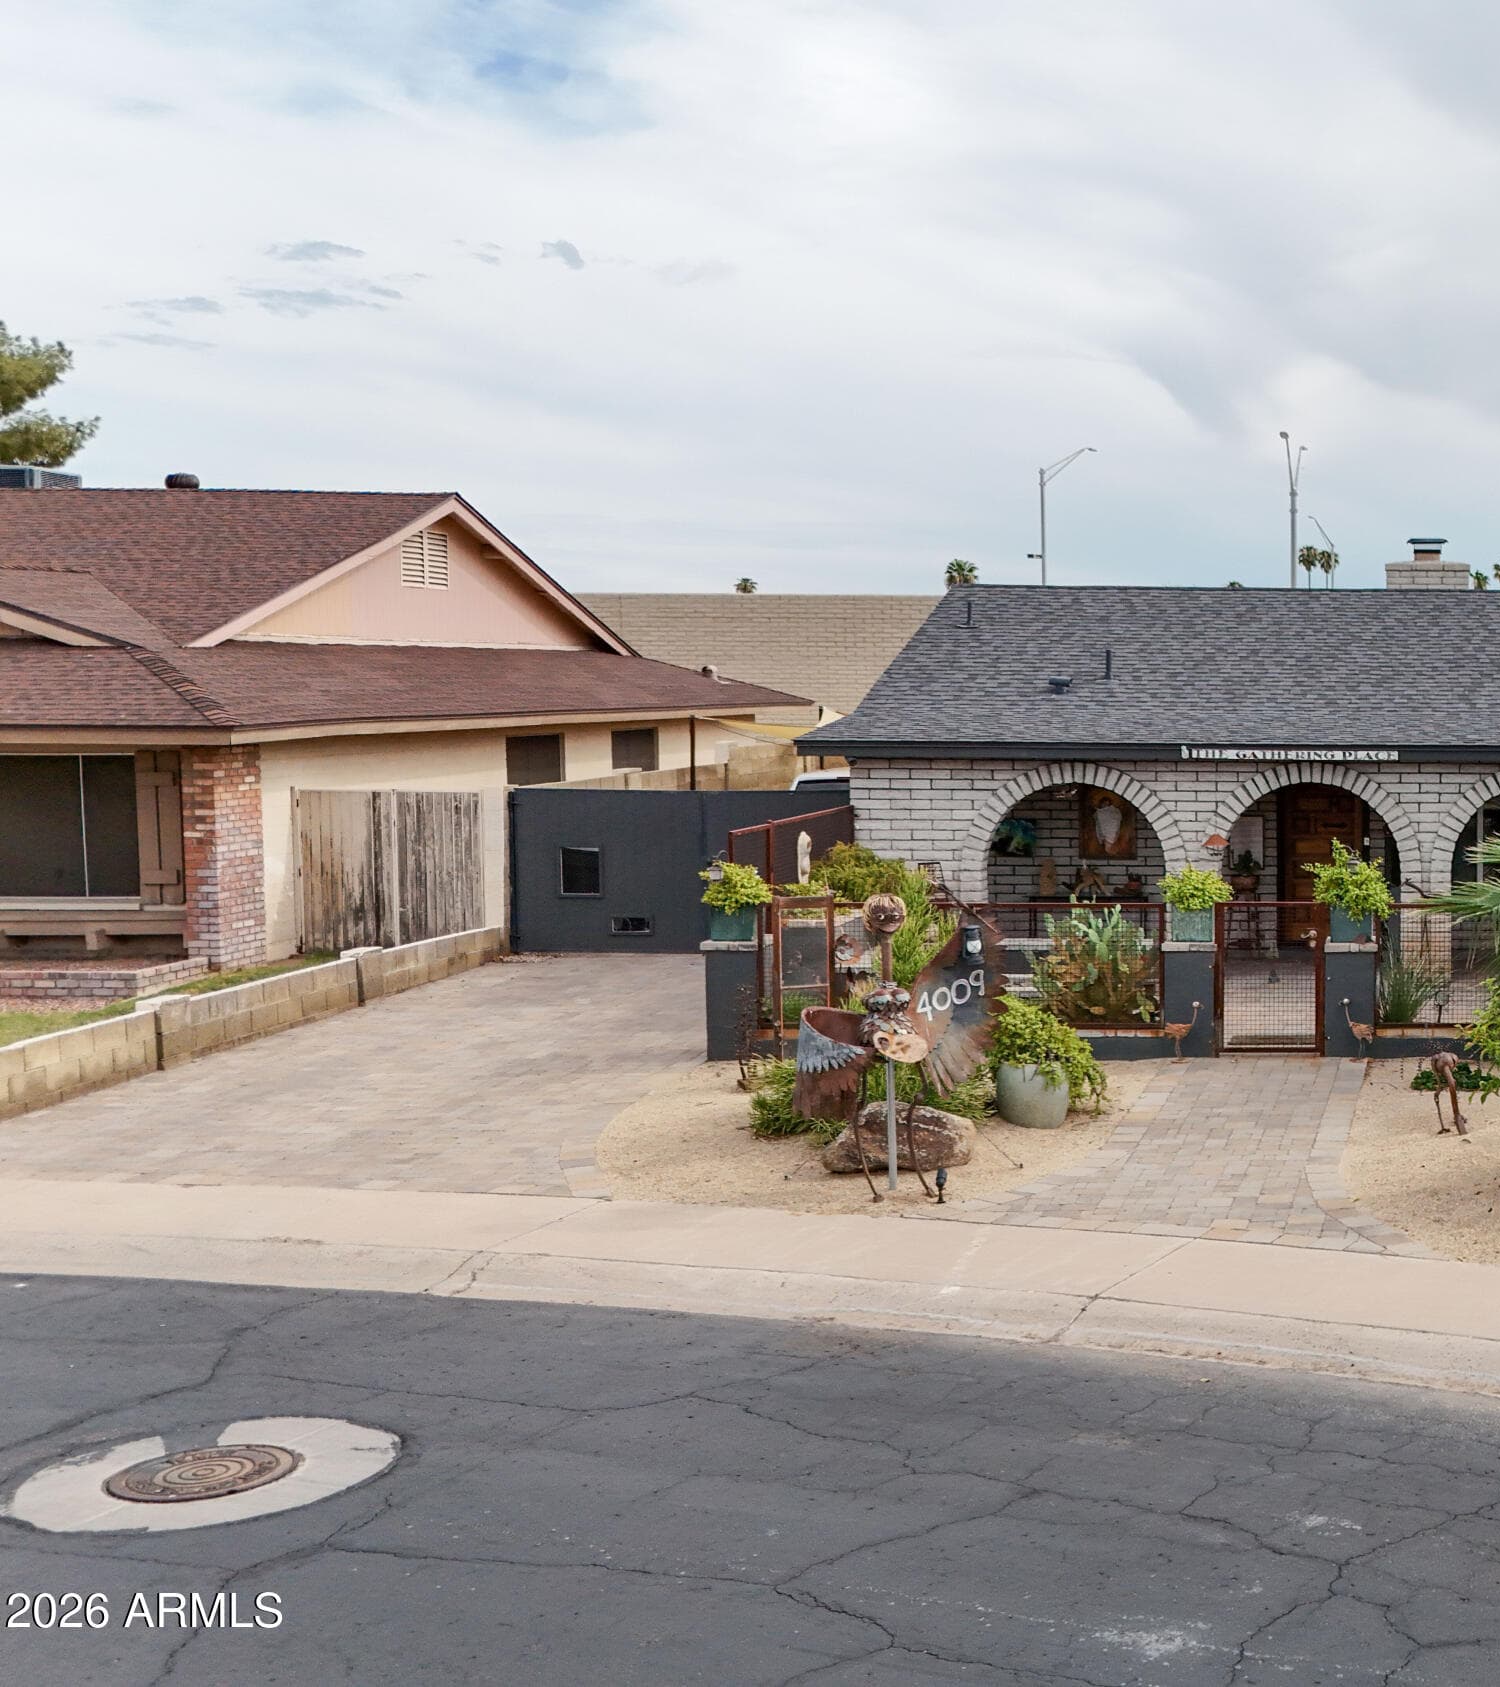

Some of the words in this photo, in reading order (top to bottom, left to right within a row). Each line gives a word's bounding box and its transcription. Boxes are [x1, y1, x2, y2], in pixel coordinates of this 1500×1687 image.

[1235, 750, 1335, 760] GATHERING
[1342, 751, 1396, 760] PLACE
[916, 969, 985, 1022] 4009
